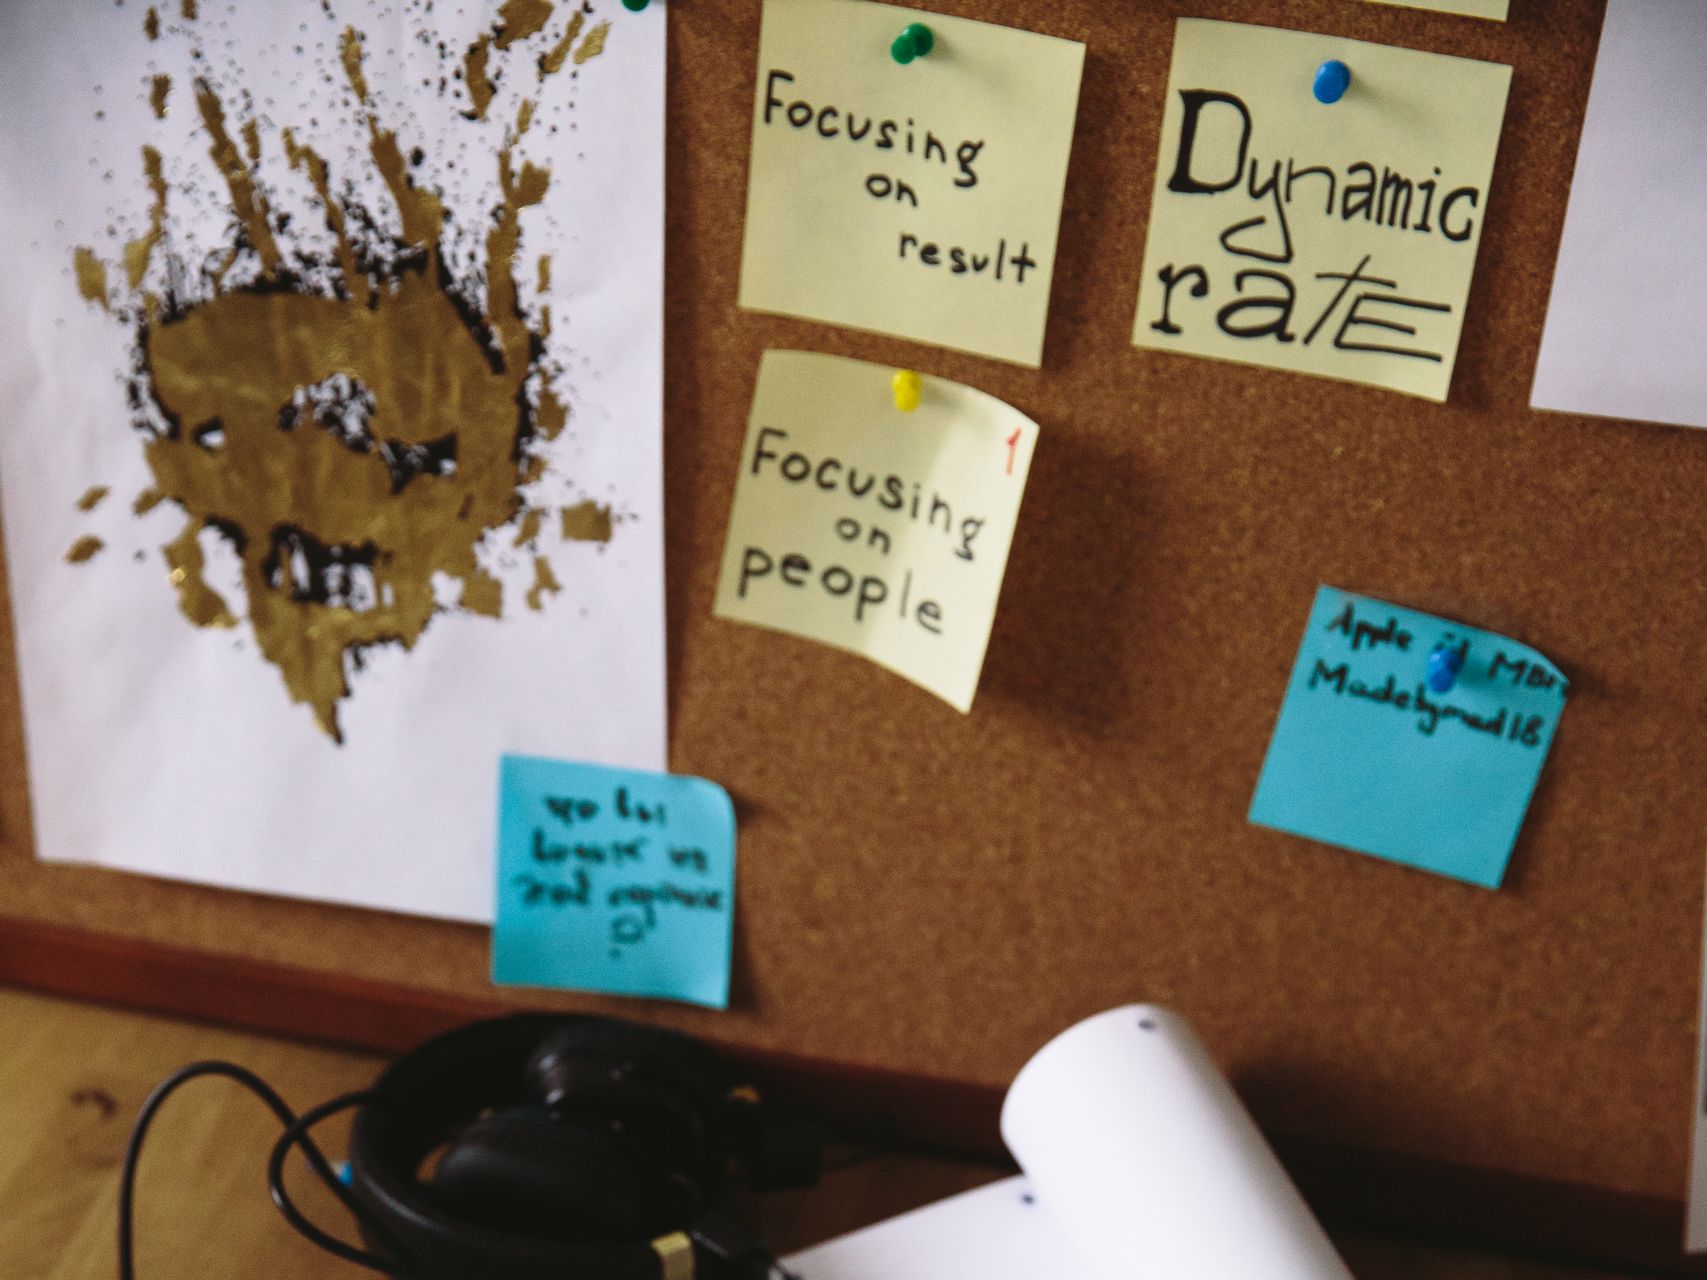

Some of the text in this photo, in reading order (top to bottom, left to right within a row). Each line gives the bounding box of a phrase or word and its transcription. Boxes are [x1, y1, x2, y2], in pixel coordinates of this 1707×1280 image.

[763, 69, 985, 188] Focusing
[865, 173, 918, 207] on
[1167, 88, 1480, 264] Dynamic
[899, 231, 1036, 283] result
[752, 425, 985, 562] Focusing
[835, 516, 893, 555] on
[736, 546, 943, 636] people
[1326, 602, 1412, 650] Apple
